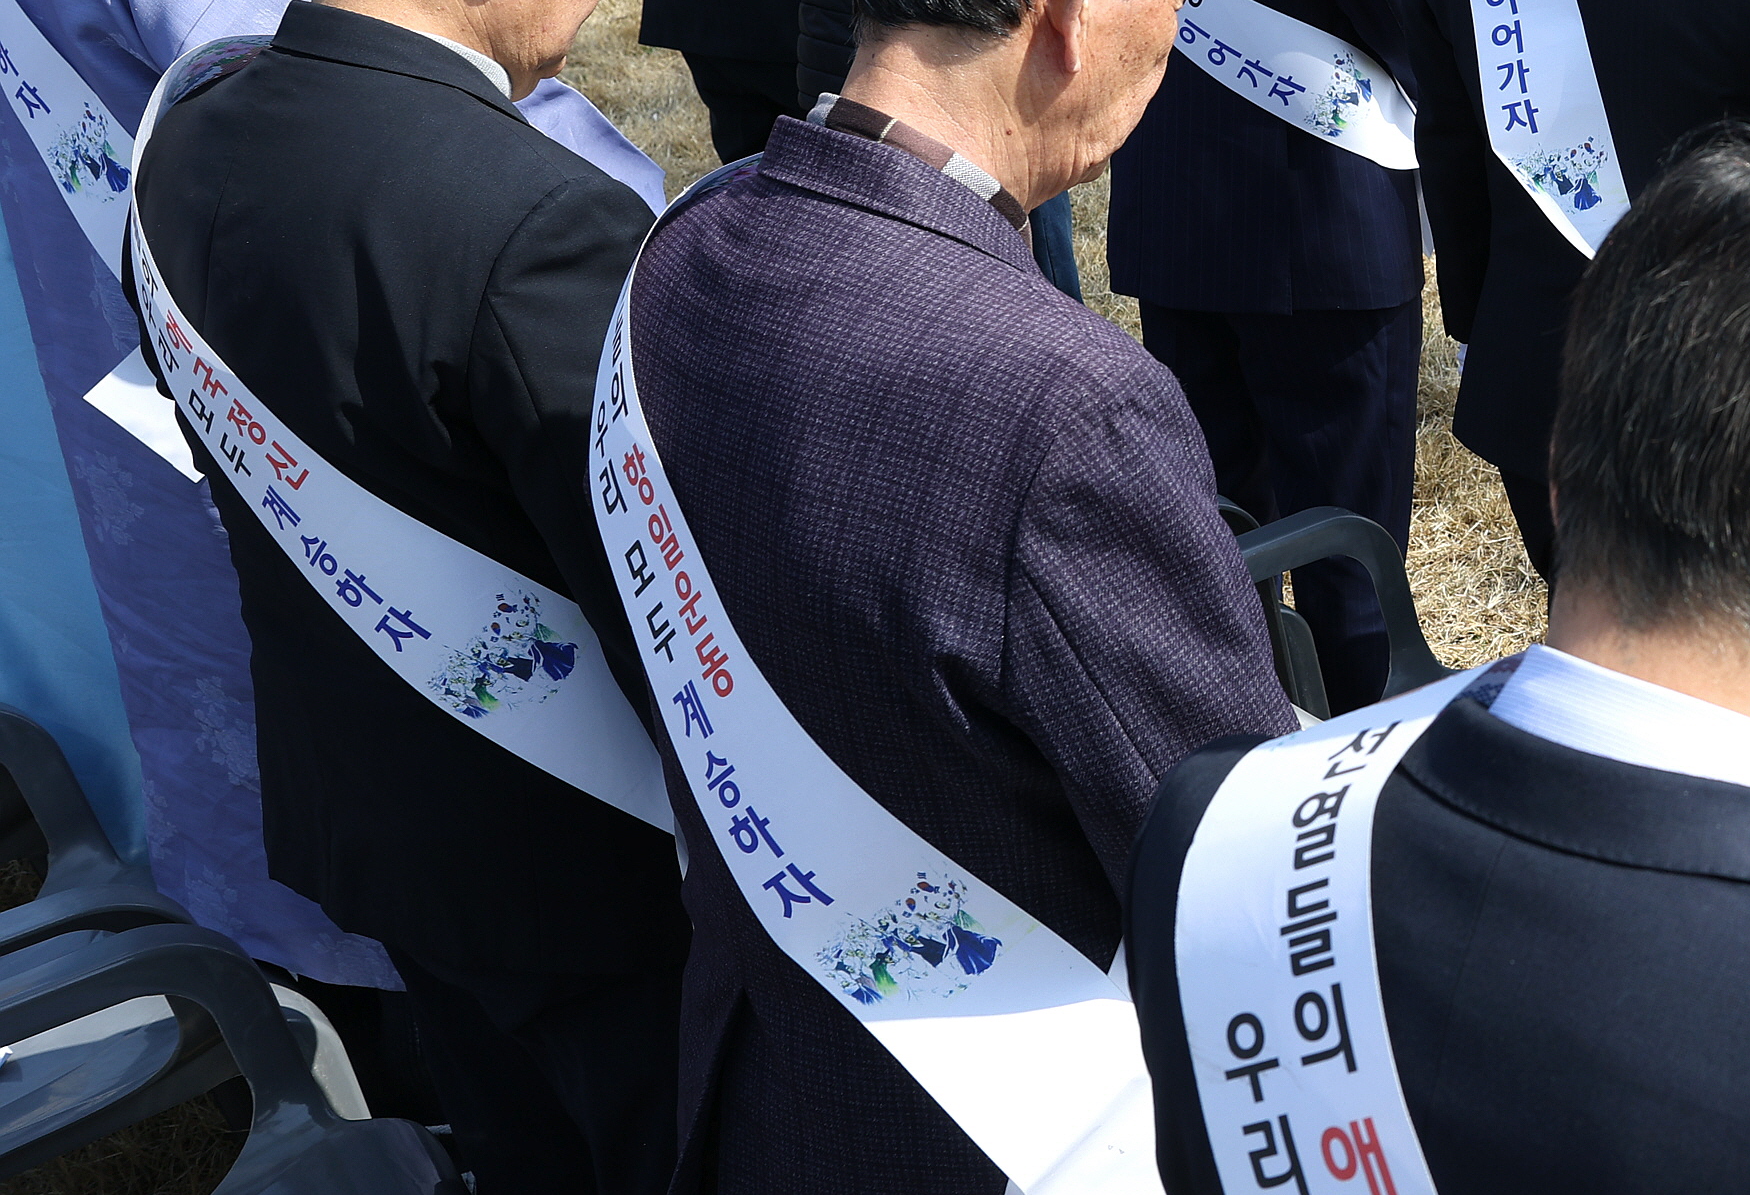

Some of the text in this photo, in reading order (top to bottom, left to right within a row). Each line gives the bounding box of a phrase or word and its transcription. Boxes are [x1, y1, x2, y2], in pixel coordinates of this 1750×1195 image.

[1179, 18, 1307, 107] 이어가자
[141, 283, 434, 652] 우리 모두 계승하자
[165, 309, 310, 491] 애국정신
[595, 401, 835, 919] 우리 모두 계승하자
[622, 443, 733, 698] 항일운동
[1279, 720, 1401, 1074] 선열들의
[1225, 1012, 1311, 1195] 우리
